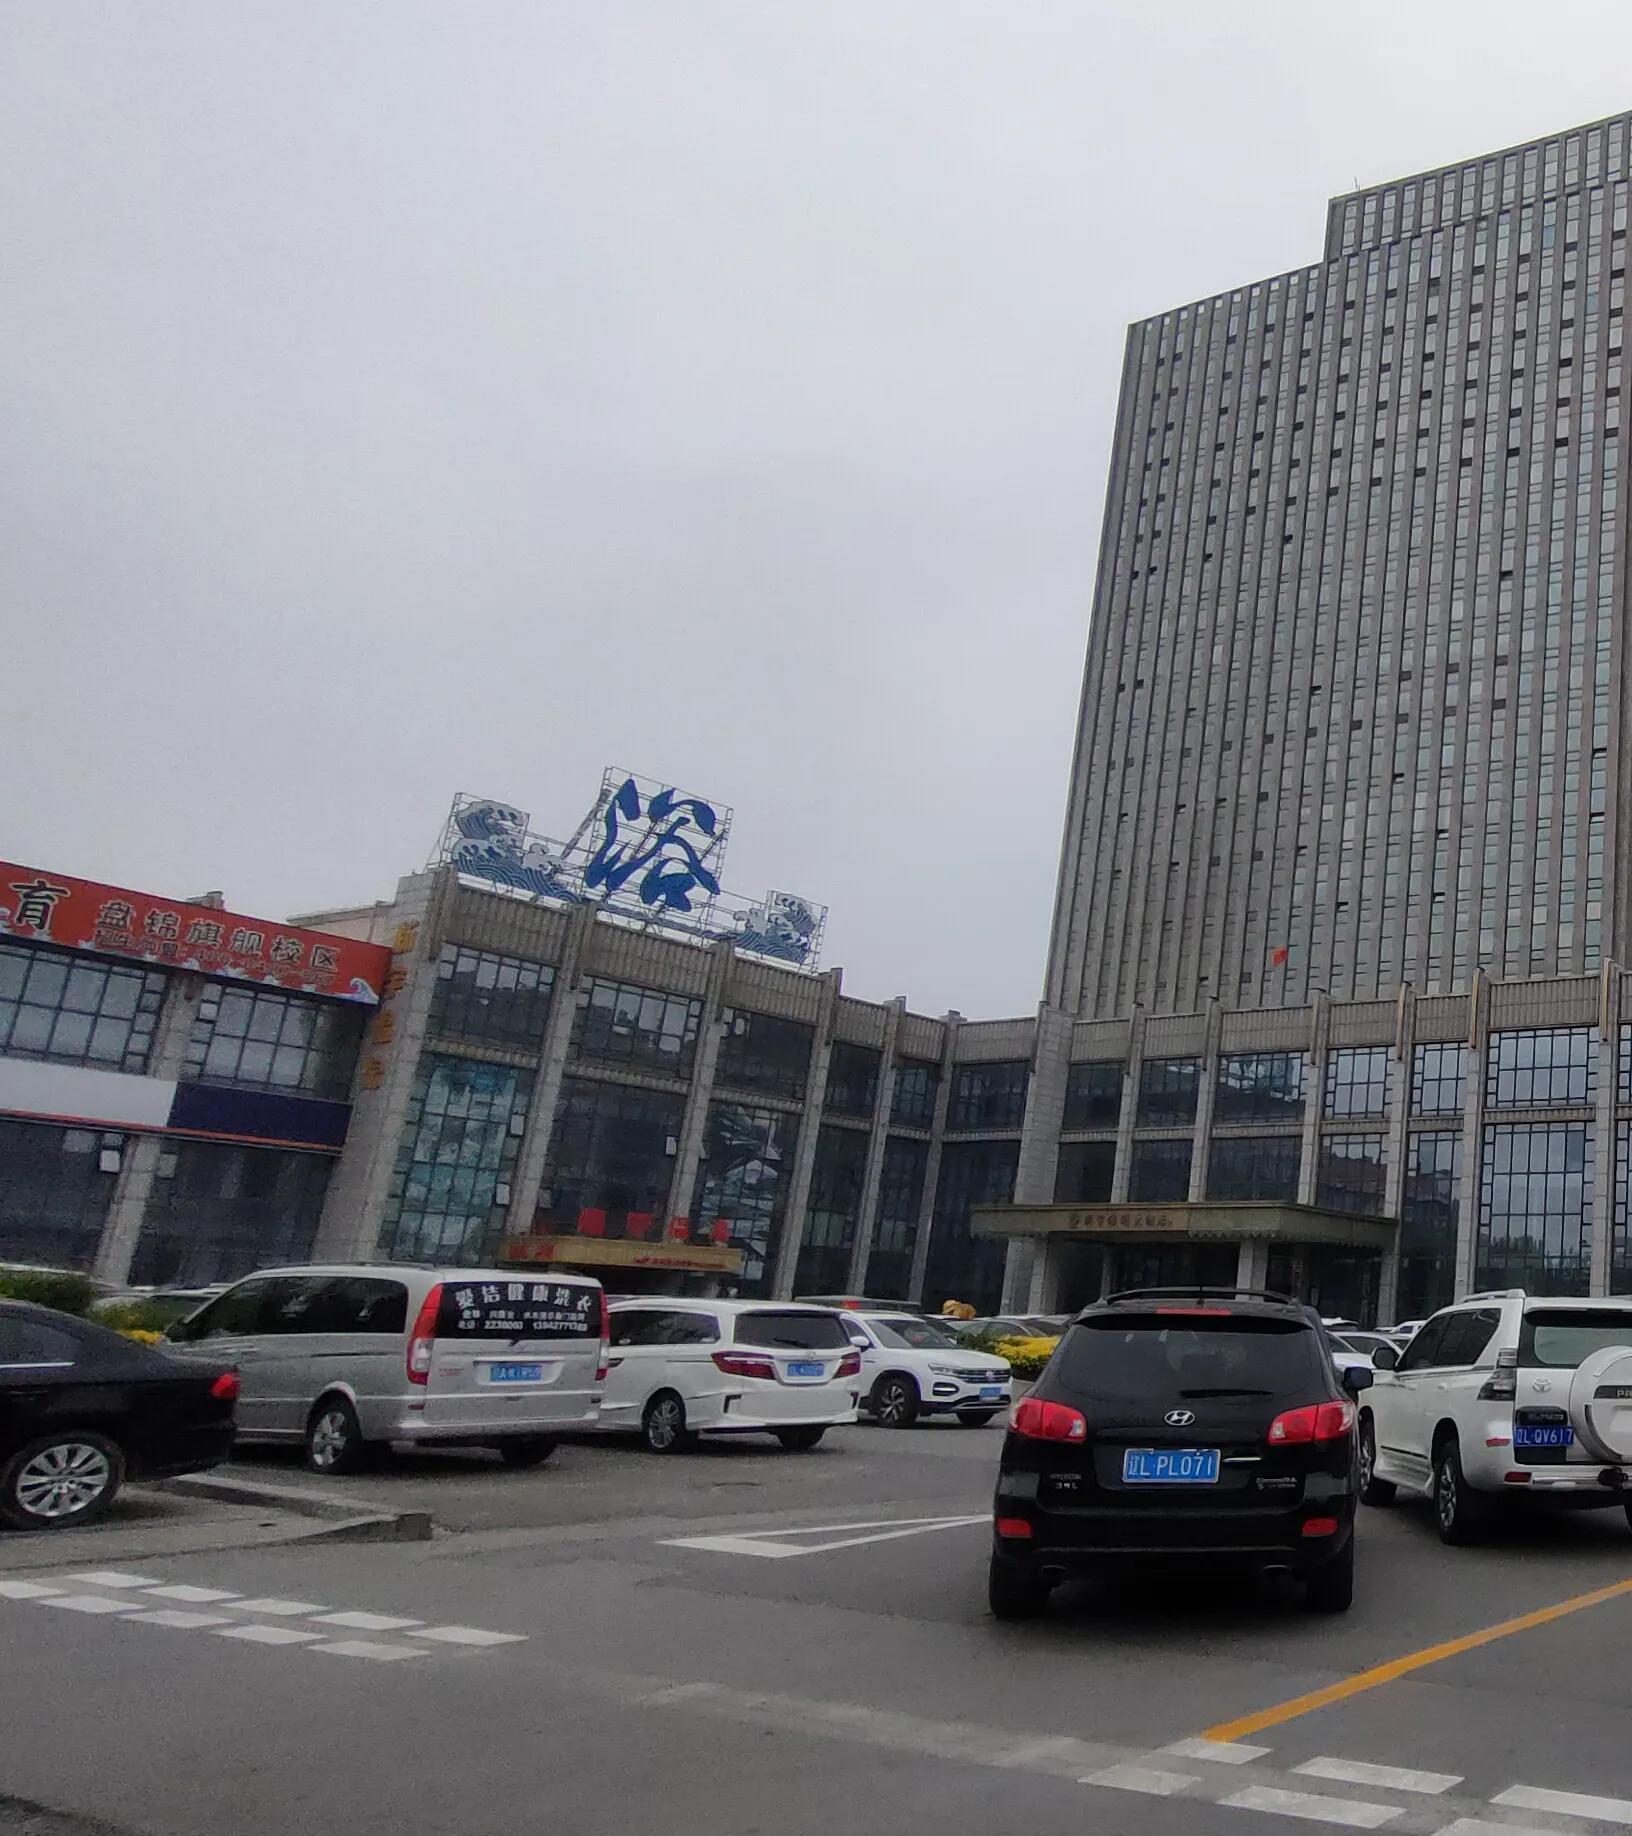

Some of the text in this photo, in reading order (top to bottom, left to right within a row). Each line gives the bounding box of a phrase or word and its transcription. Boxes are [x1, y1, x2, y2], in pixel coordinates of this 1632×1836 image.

[584, 778, 721, 912] 浴
[9, 879, 70, 931] 育
[97, 900, 342, 972] 盘锦旗舰校区
